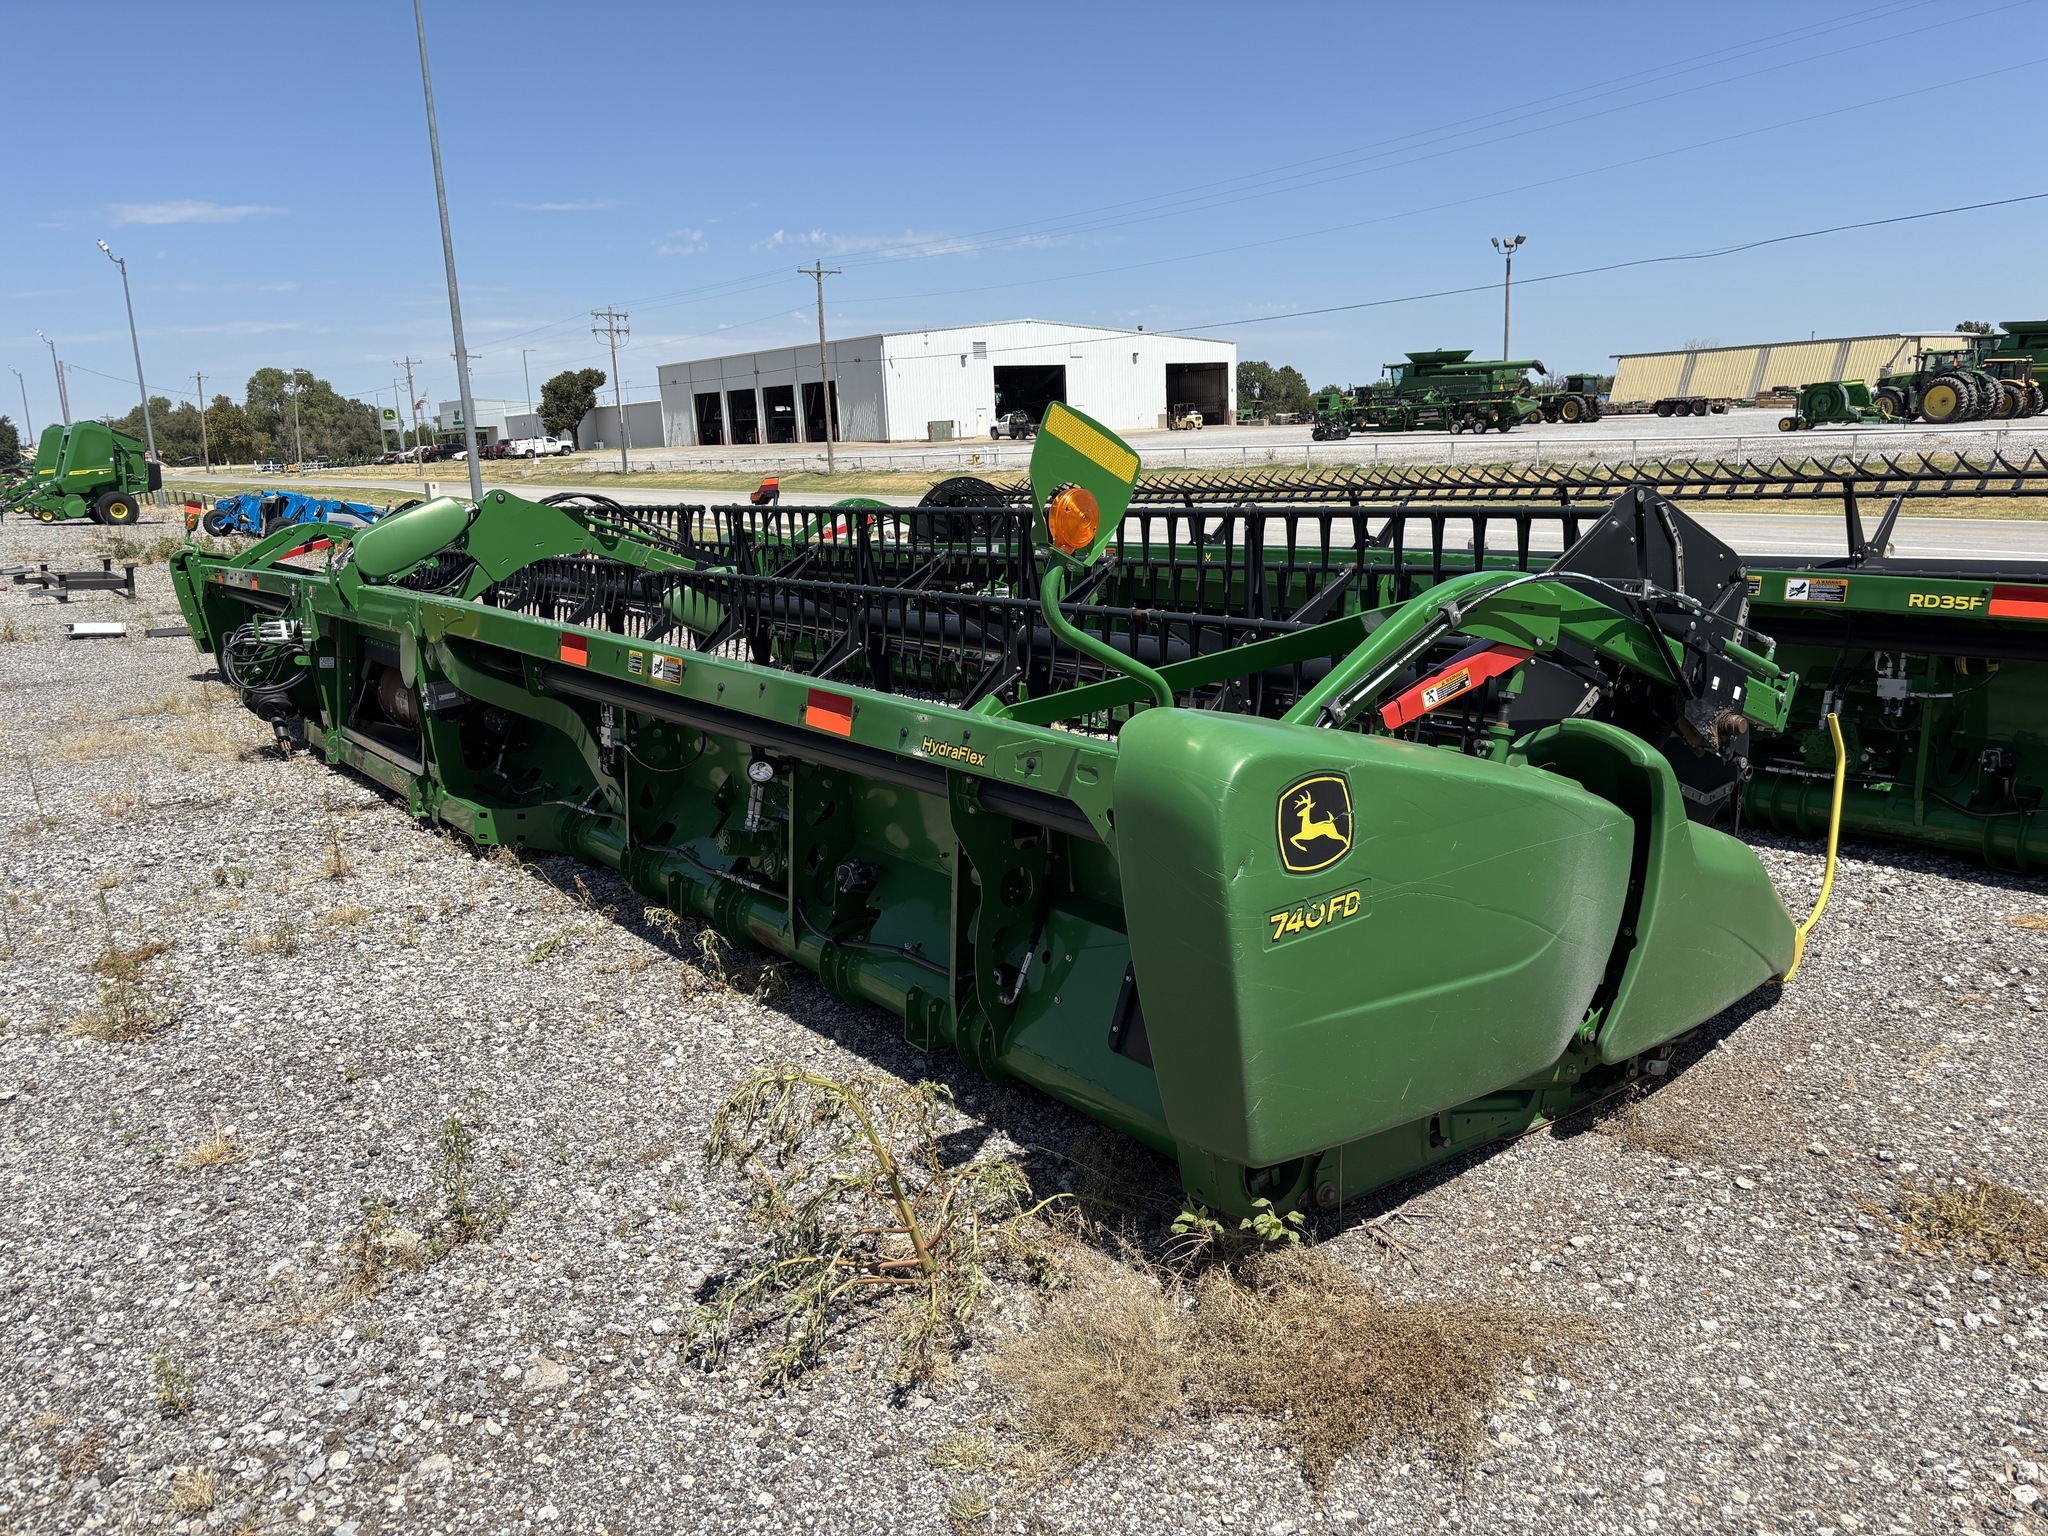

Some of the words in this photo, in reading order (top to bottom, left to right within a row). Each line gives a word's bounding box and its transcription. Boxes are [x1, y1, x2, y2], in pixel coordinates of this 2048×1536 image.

[1908, 593, 1986, 611] RD35F
[921, 736, 987, 767] HydraFlex
[1269, 889, 1361, 943] 740FD
